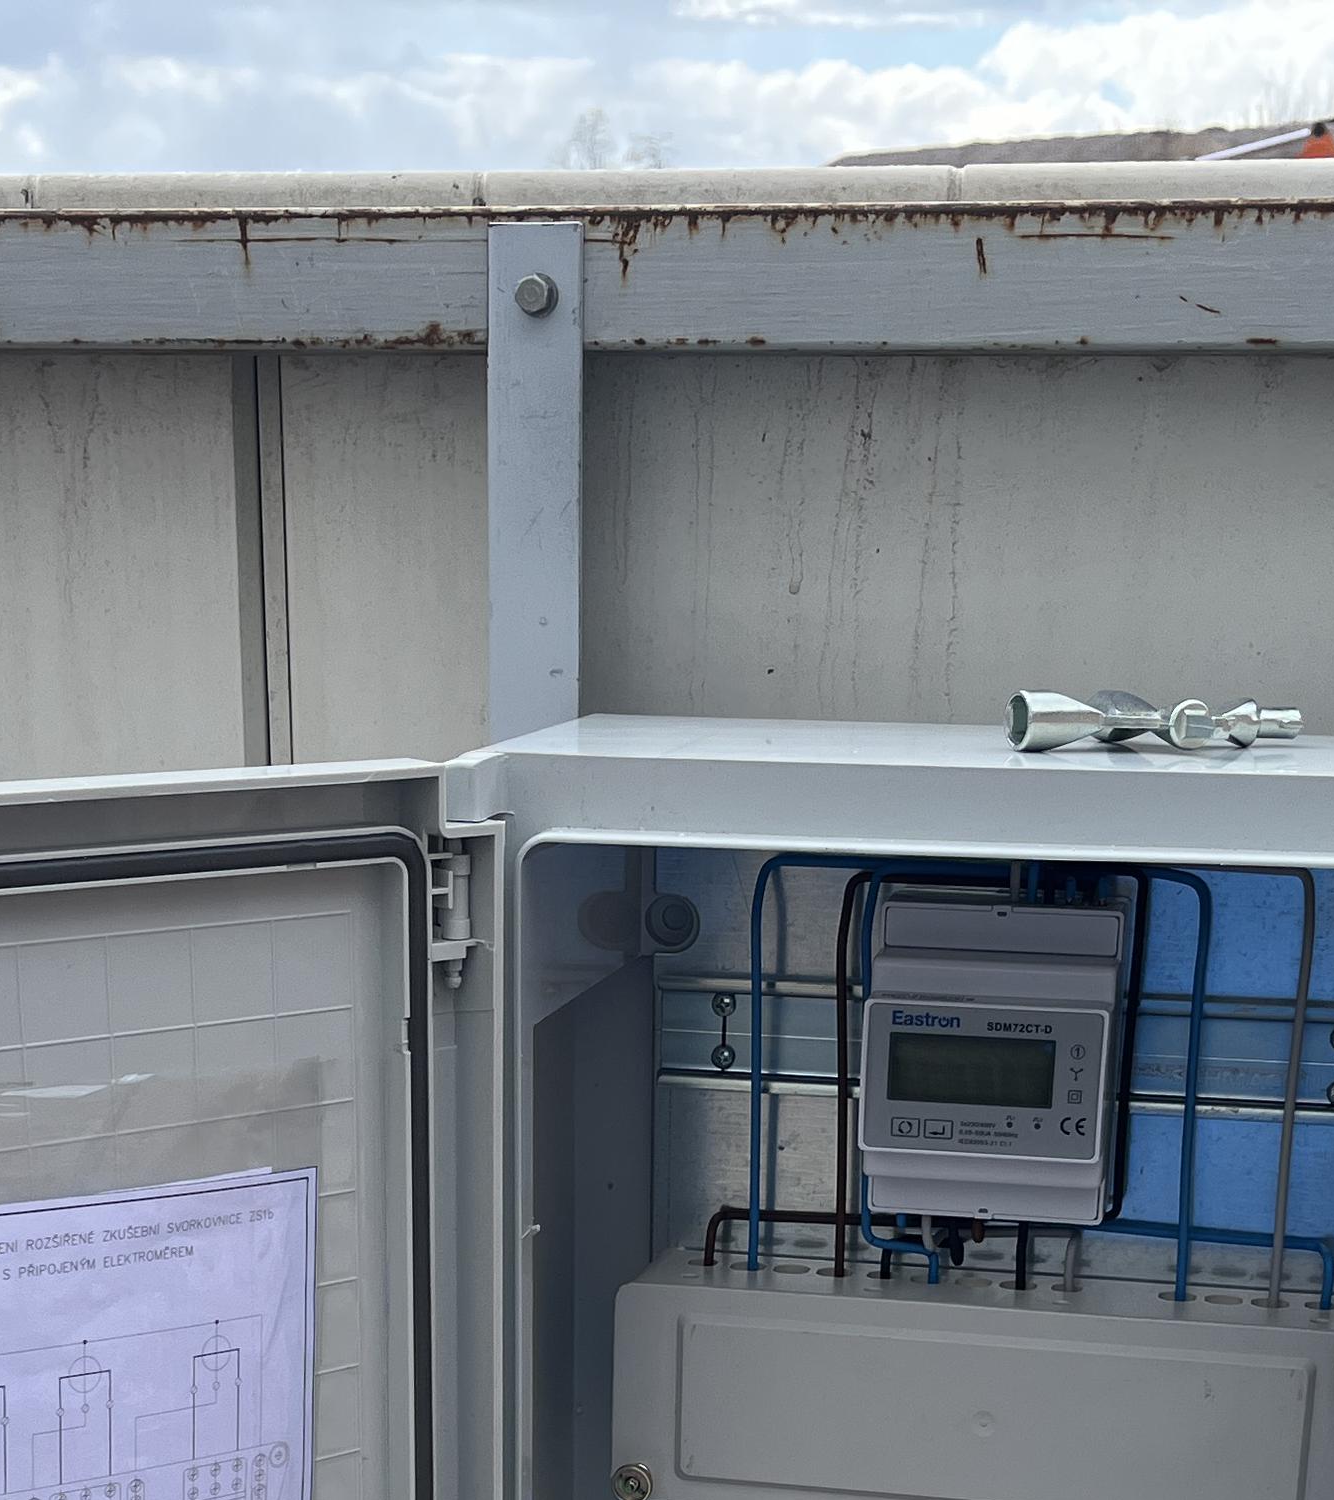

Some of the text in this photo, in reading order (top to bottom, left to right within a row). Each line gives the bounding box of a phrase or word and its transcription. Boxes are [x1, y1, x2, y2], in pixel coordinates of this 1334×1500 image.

[892, 1010, 961, 1029] Eastron
[986, 1021, 1053, 1035] SDM72CT-D
[167, 1212, 243, 1234] SVORKOVNICE
[2, 1268, 11, 1281] S
[18, 1257, 95, 1279] PŘIPOJENÝM
